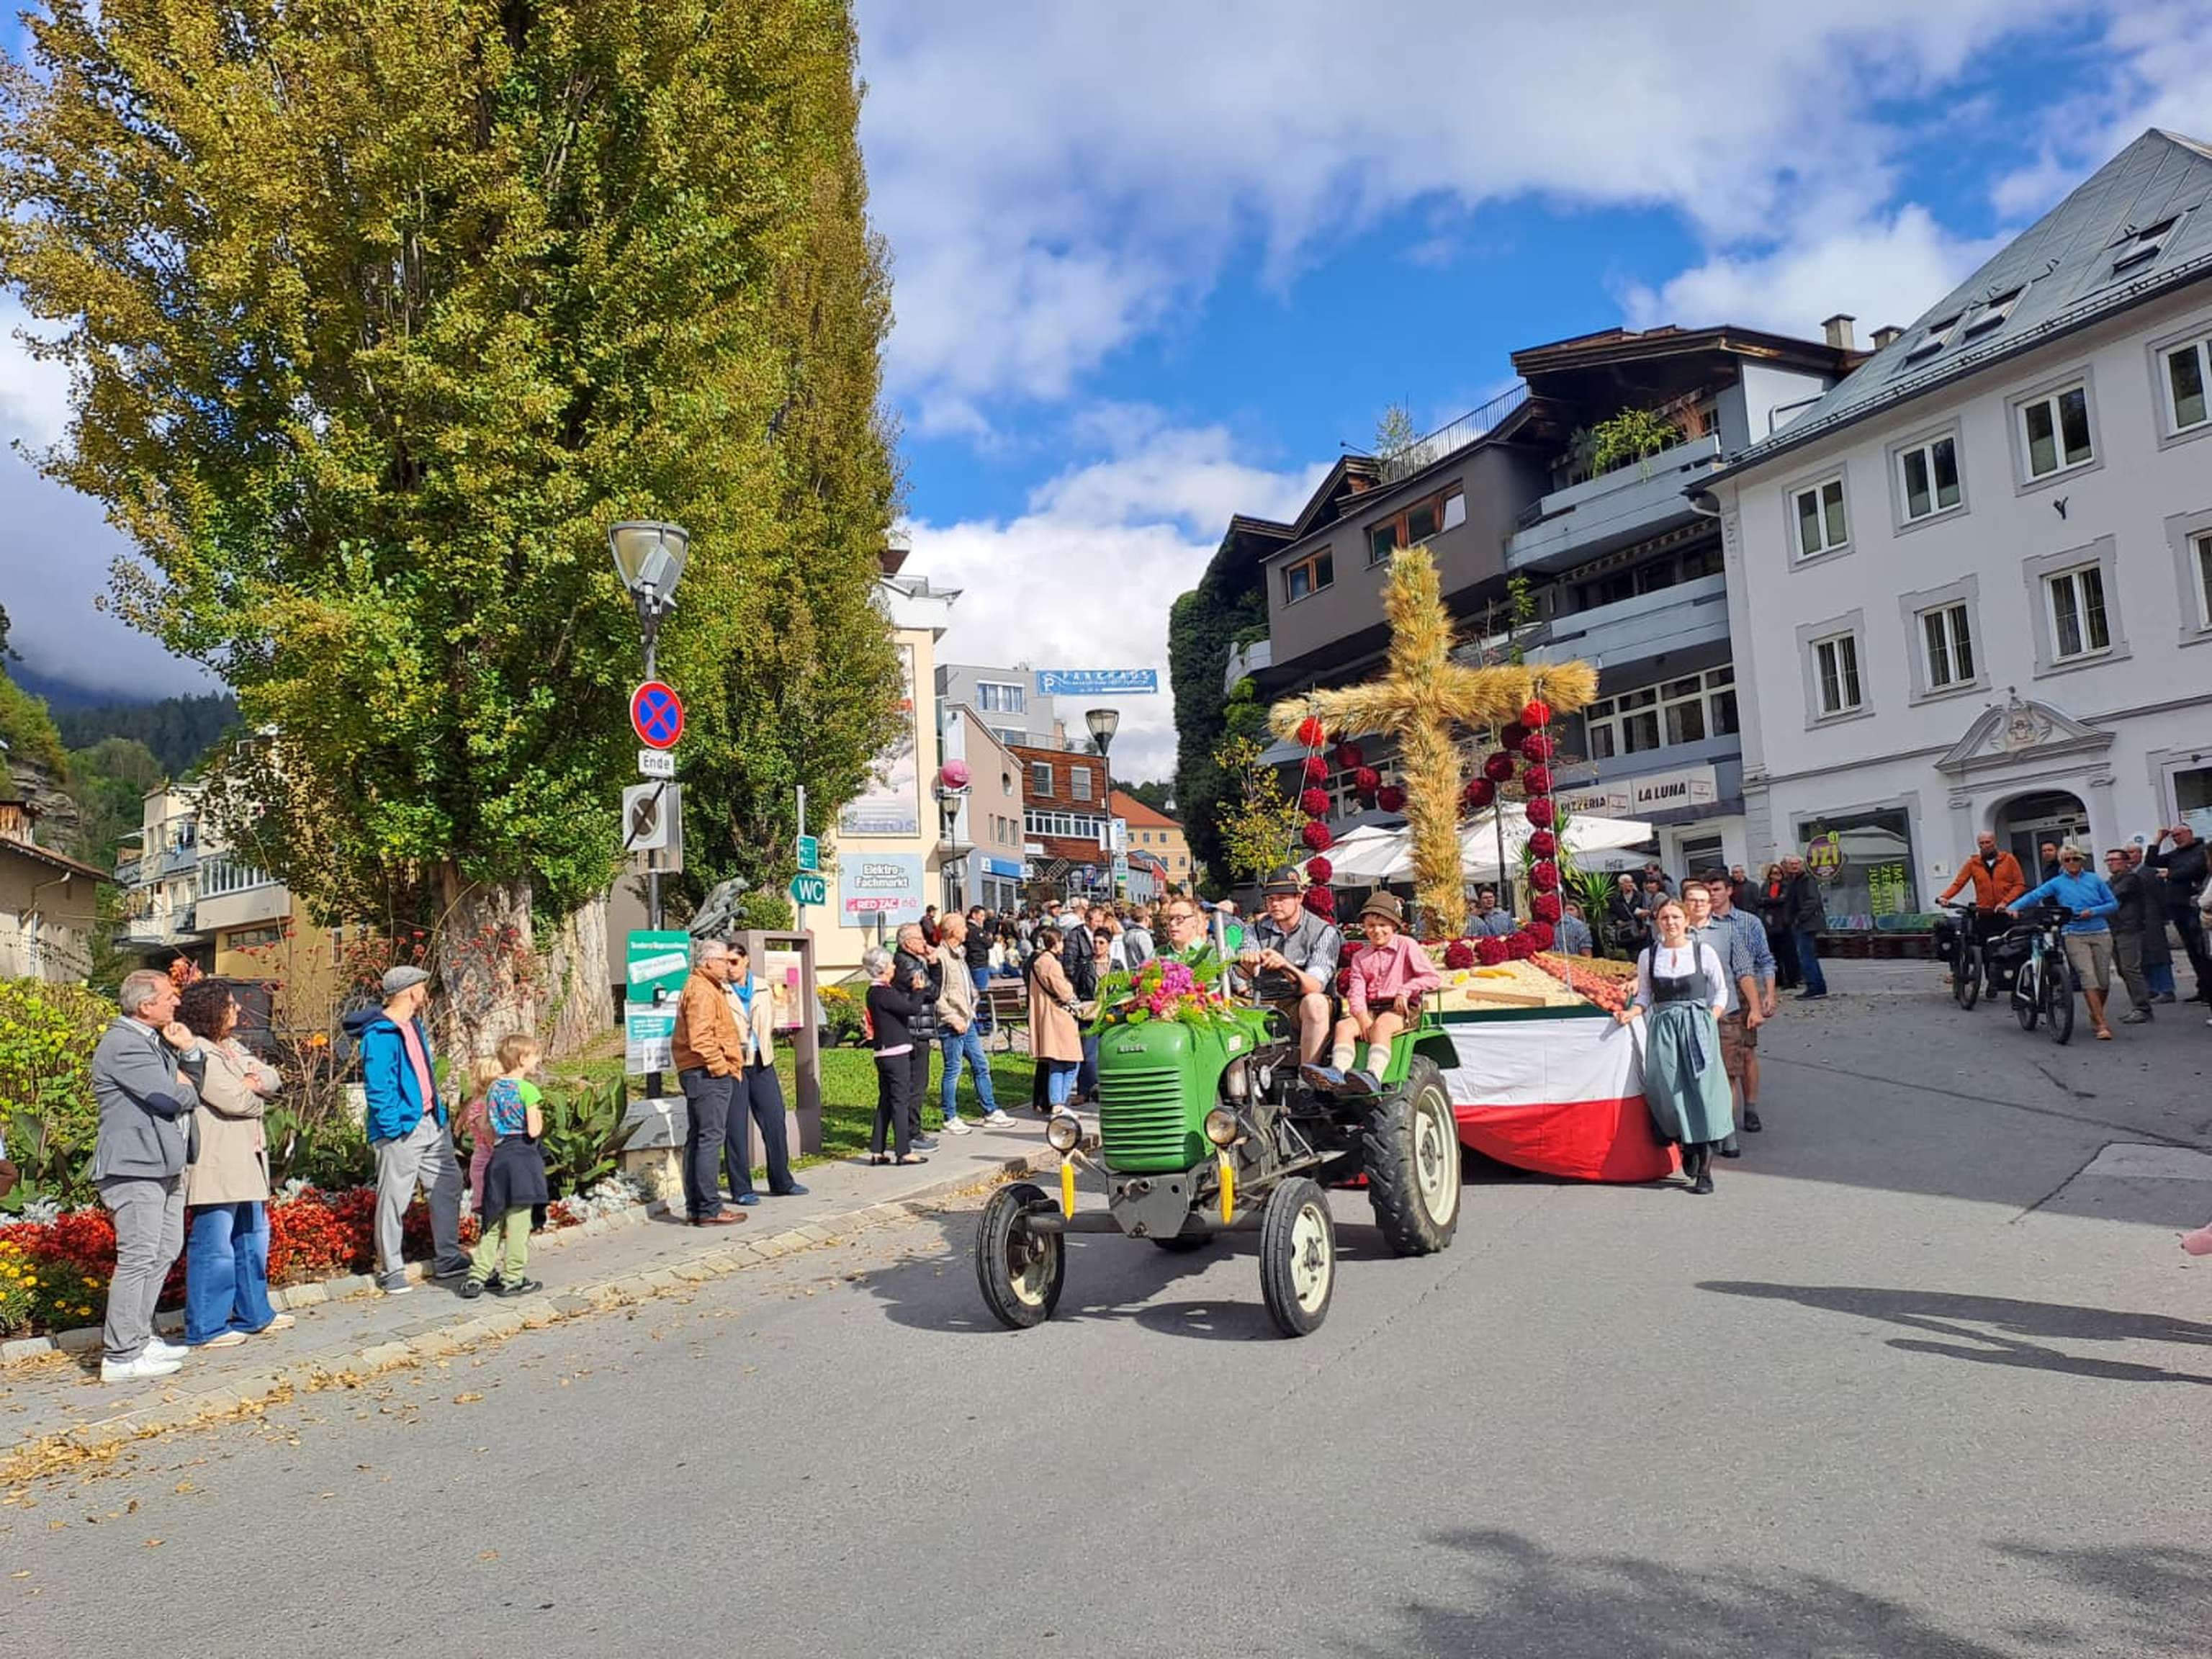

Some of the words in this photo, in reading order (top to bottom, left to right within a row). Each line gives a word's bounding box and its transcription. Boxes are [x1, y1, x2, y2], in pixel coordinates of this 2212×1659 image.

[643, 755, 670, 770] Ende
[1637, 788, 1653, 802] LA
[1655, 783, 1686, 799] LUNA
[1560, 796, 1606, 812] PIZZERIA
[855, 876, 909, 889] Fachmarkt
[799, 879, 823, 902] WC
[856, 899, 878, 909] RED
[878, 899, 897, 909] ZAC
